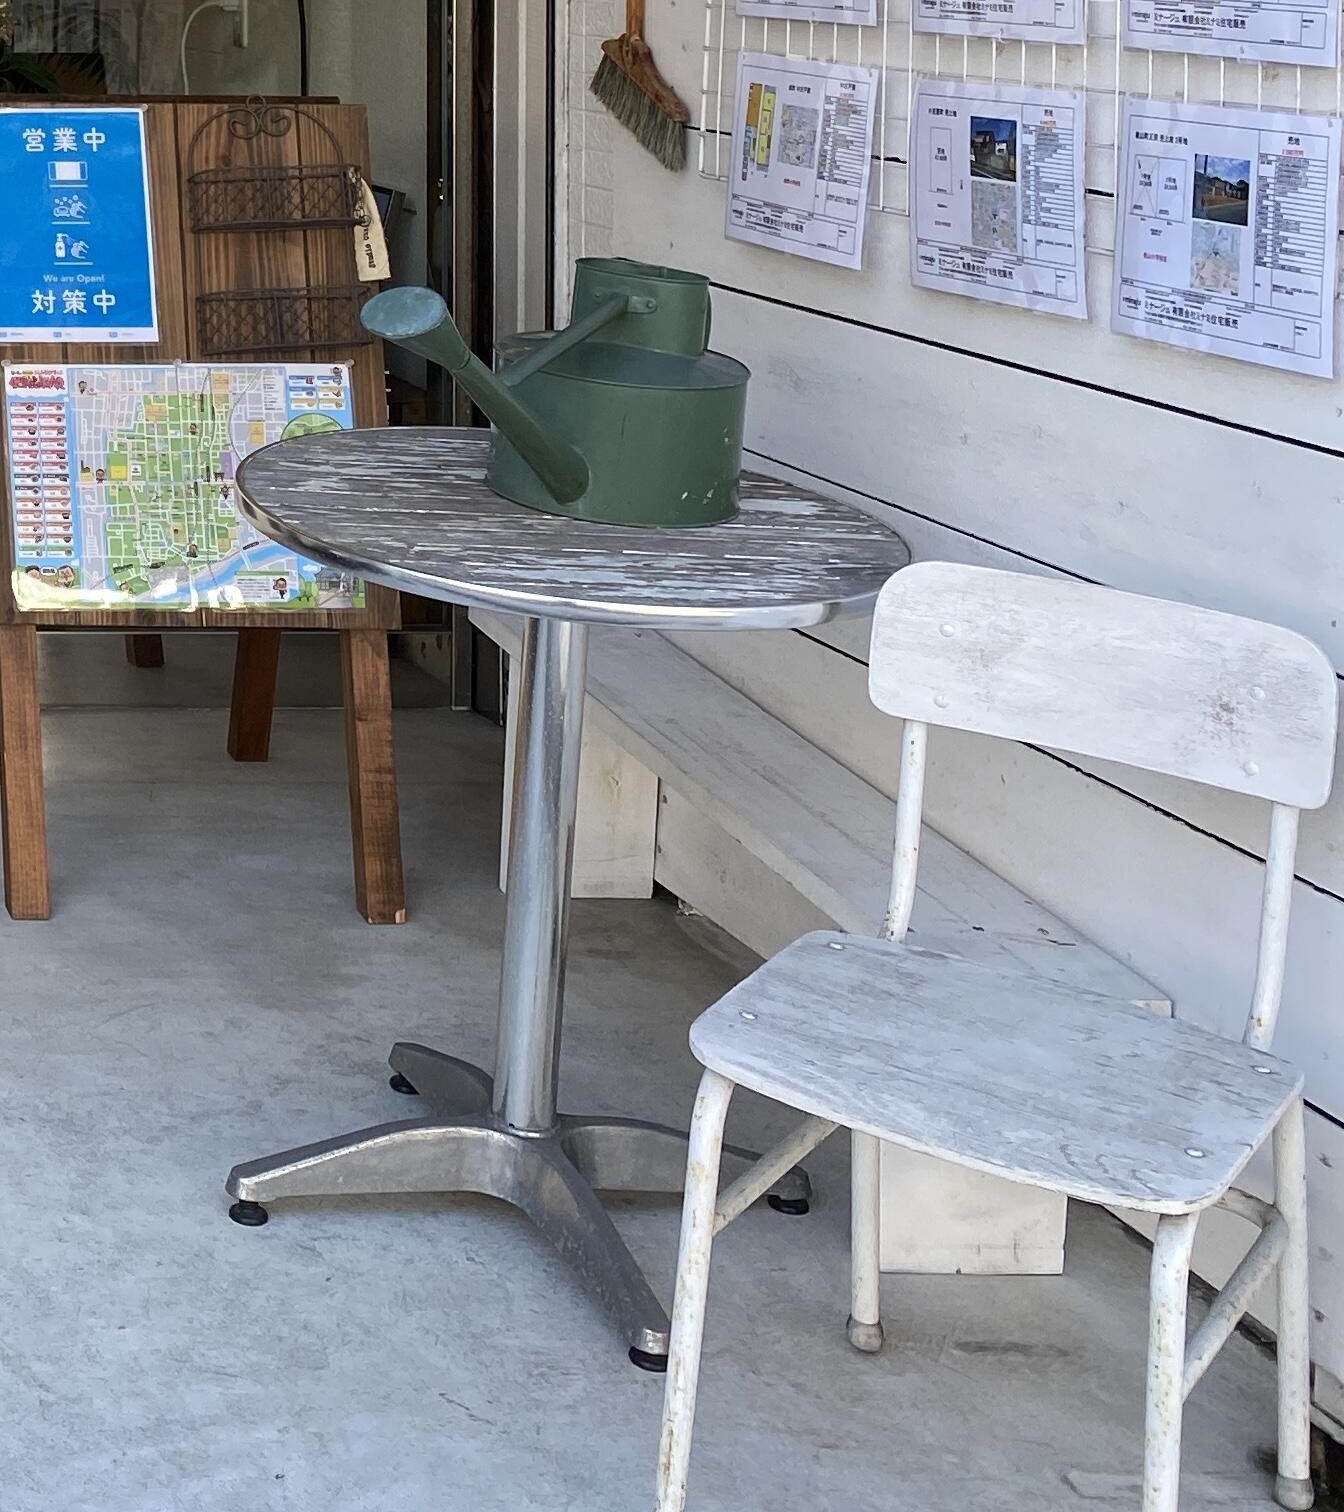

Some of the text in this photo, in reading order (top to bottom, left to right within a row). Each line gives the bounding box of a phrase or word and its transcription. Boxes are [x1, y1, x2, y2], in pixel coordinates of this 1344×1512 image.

[22, 127, 106, 152] 営業中
[43, 274, 58, 283] We
[77, 274, 105, 284] Open!
[31, 290, 116, 315] 対策中
[1144, 300, 1171, 315] ミナージュ
[1172, 306, 1239, 330] 有限会社ミナミ住宅販売
